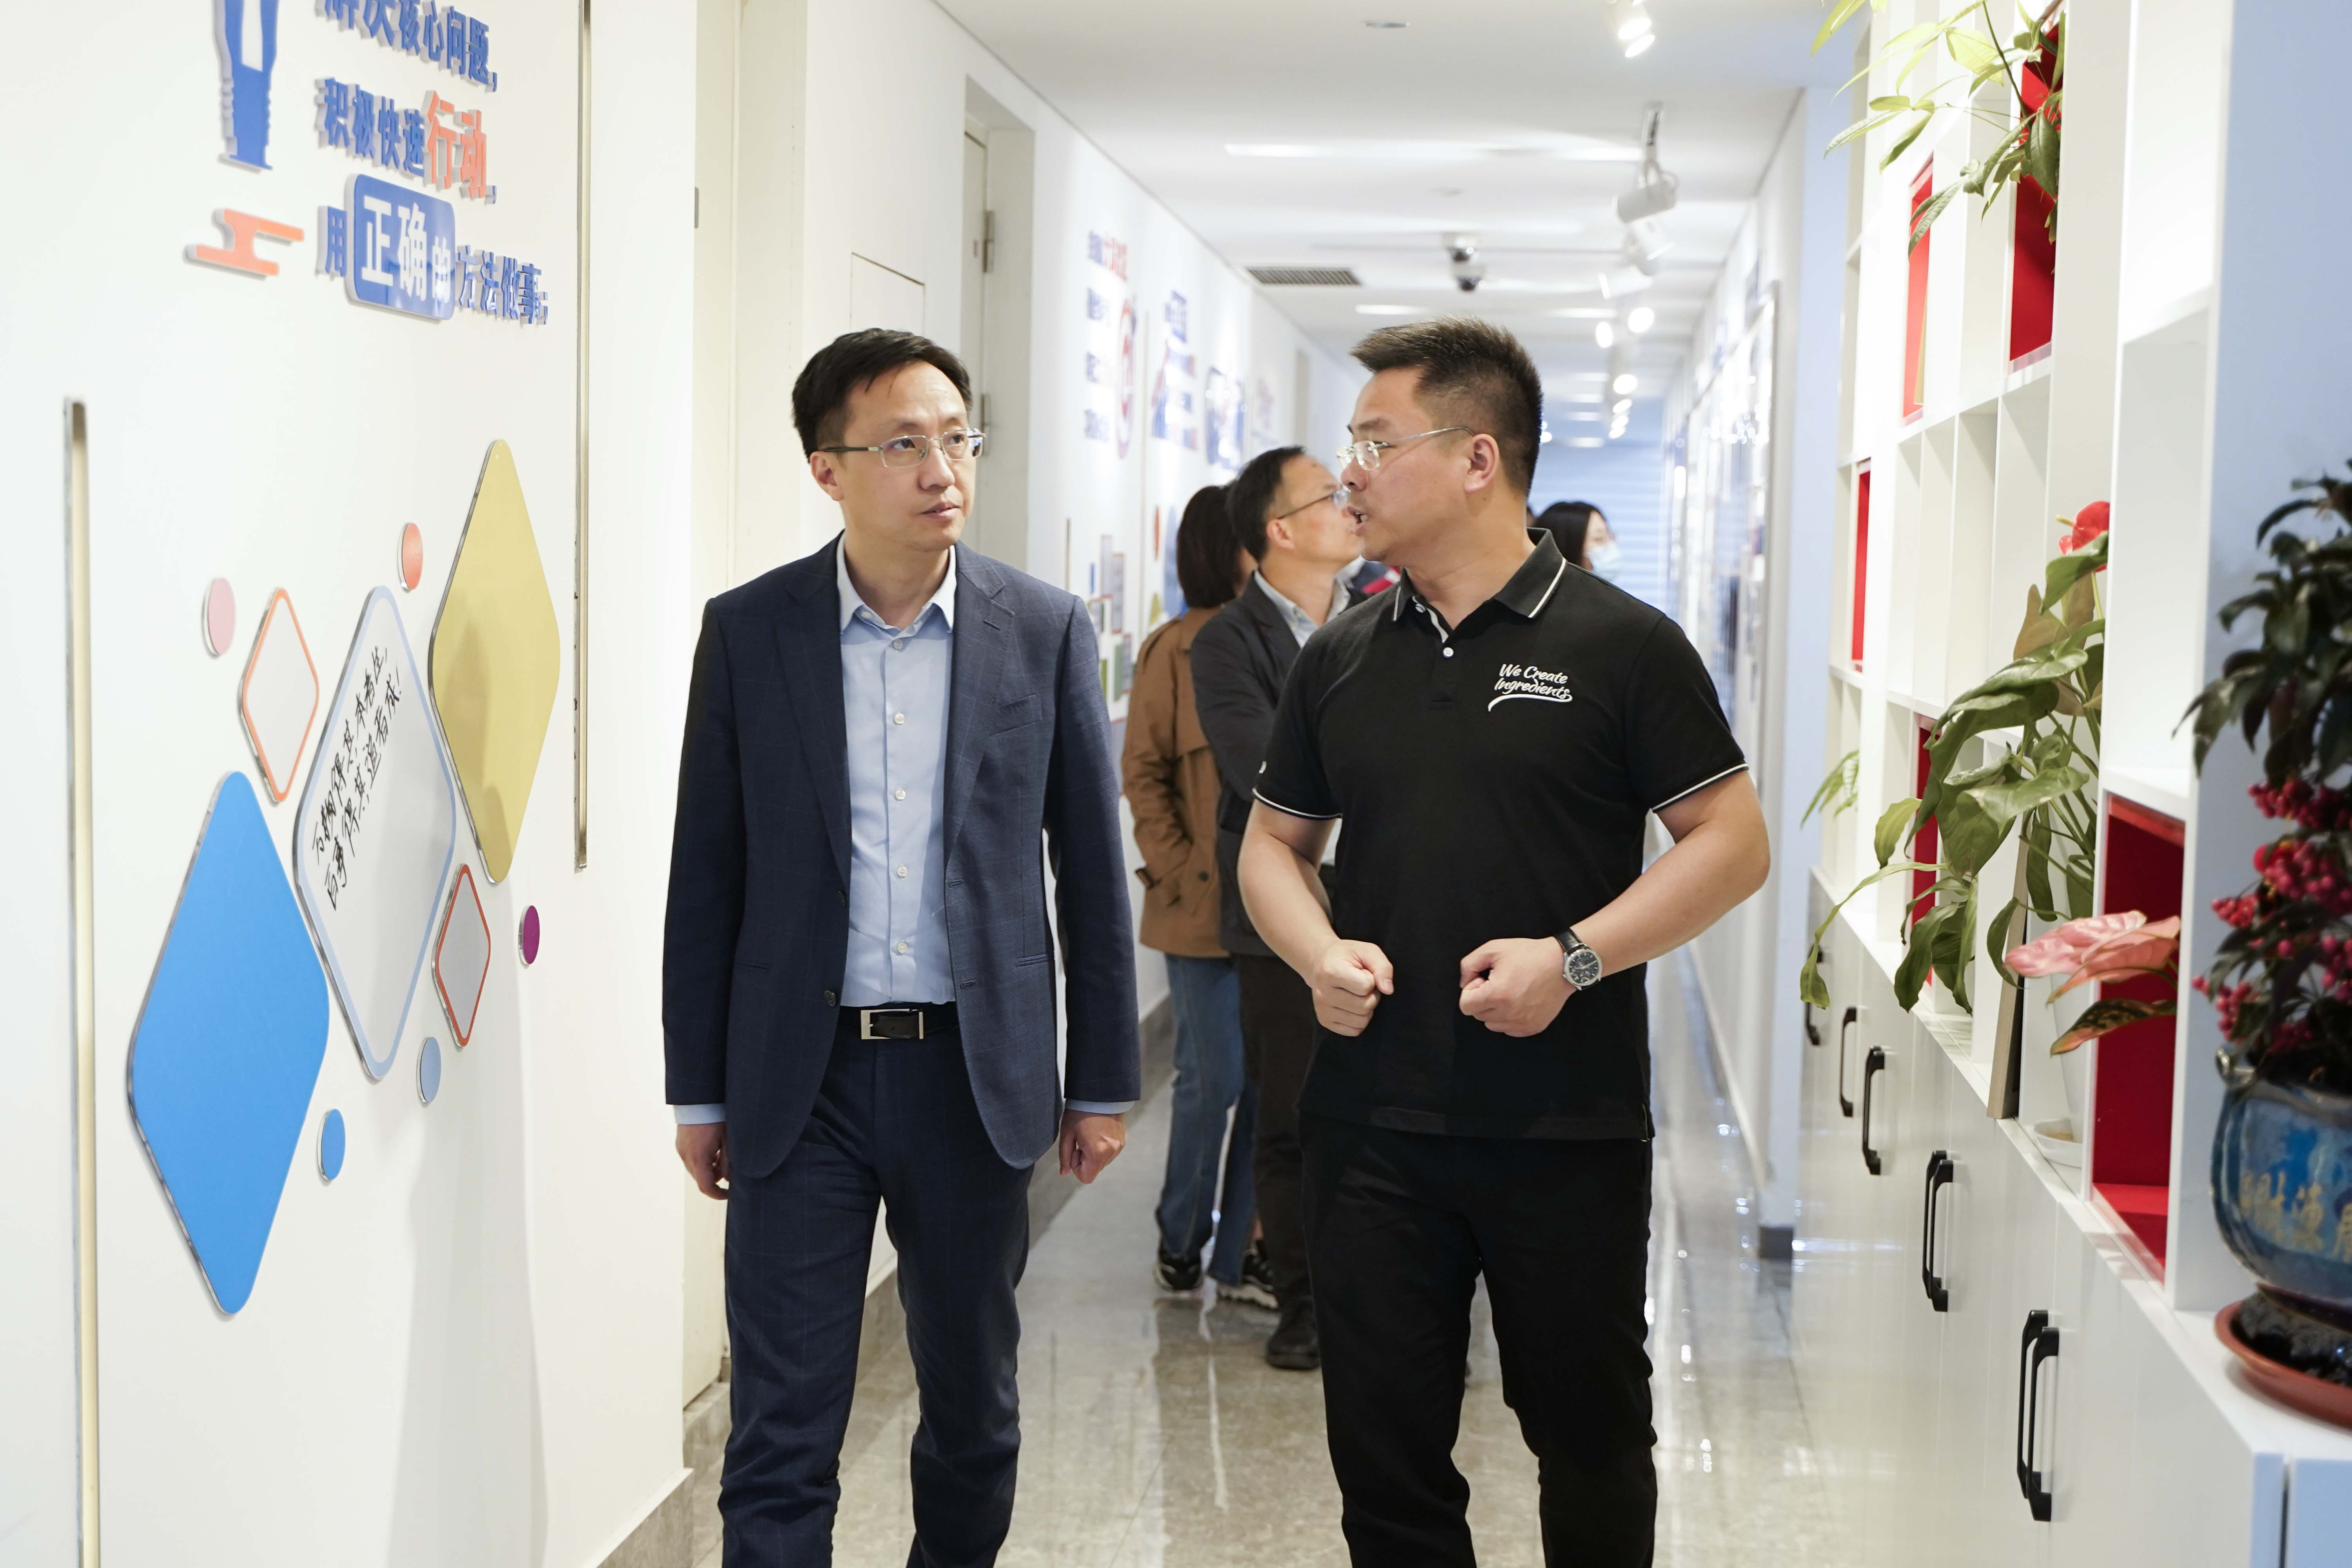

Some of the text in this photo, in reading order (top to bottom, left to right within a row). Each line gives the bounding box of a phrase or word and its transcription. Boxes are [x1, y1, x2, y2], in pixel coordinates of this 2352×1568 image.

[1499, 664, 1568, 684] We Create
[1494, 677, 1571, 700] Ingredients
